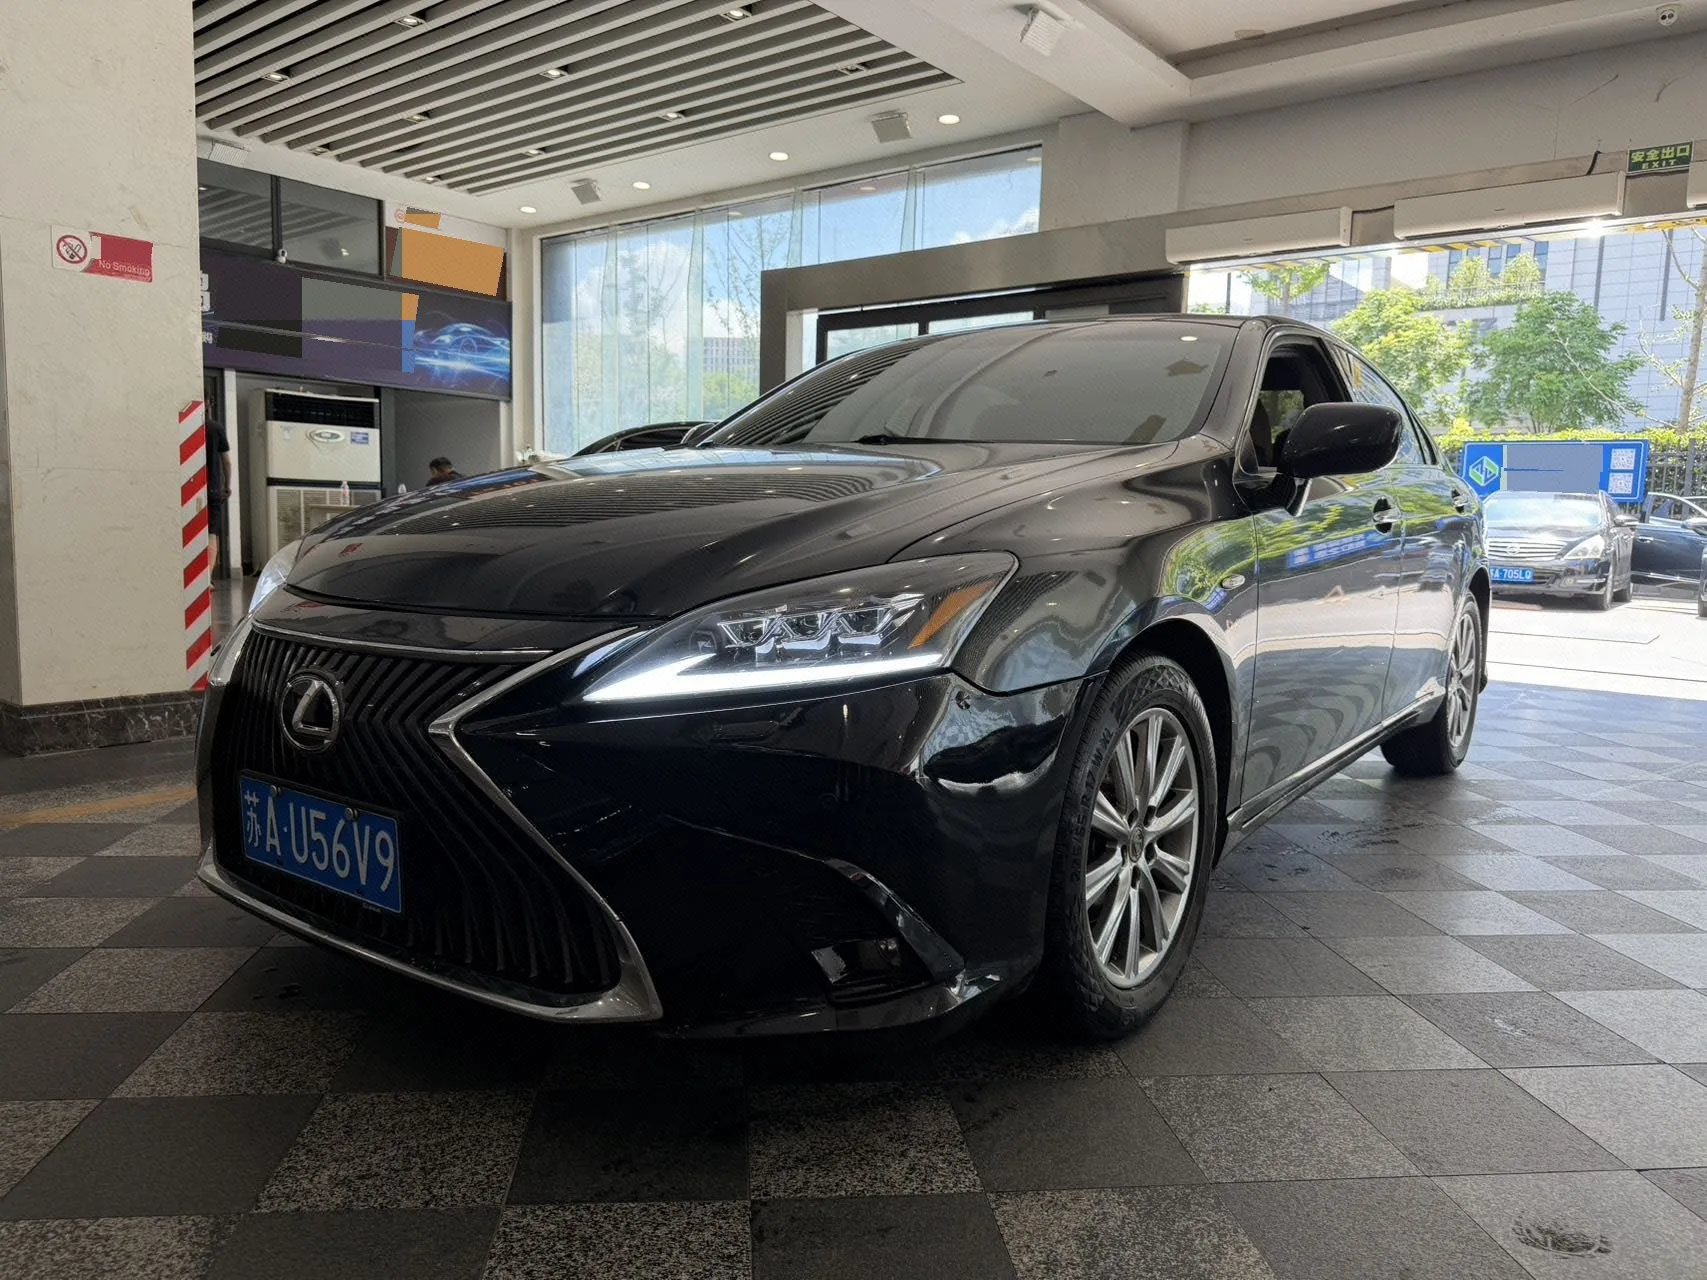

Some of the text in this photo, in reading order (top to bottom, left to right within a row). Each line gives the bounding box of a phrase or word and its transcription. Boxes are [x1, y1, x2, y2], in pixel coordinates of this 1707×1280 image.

[1631, 145, 1690, 162] 安全出口
[1642, 160, 1677, 170] EXIT
[99, 260, 150, 276] No Smoking
[244, 790, 395, 892] 苏A·U56V9
